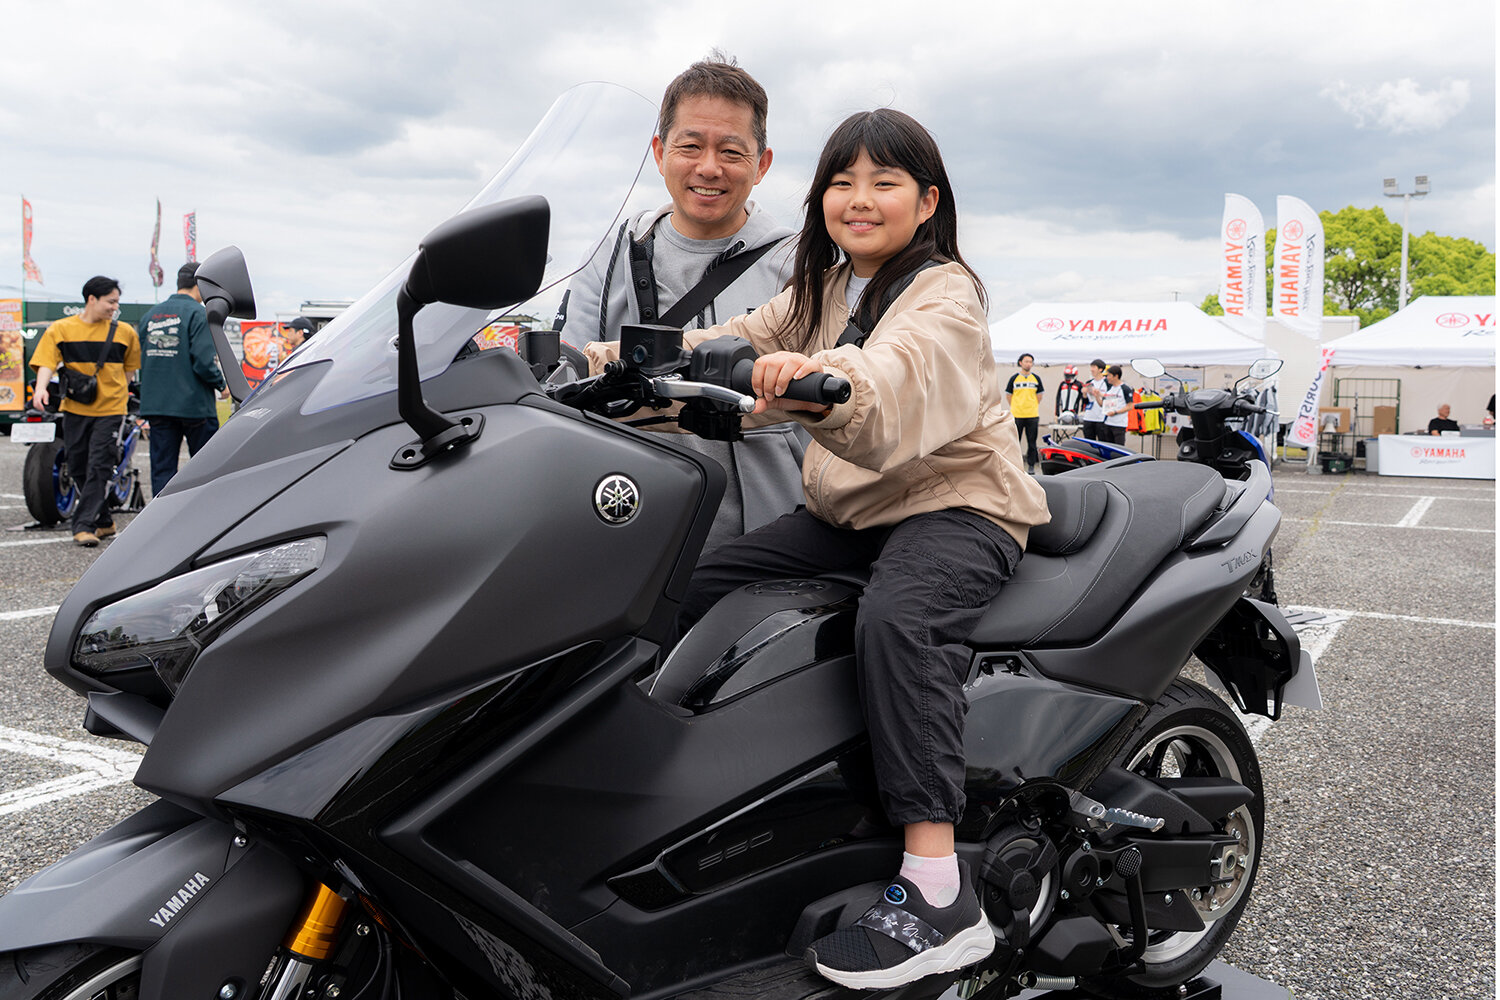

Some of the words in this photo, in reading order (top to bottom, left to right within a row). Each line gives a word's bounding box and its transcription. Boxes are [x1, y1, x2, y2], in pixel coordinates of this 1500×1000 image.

[1069, 319, 1168, 332] YAMAHA
[1423, 448, 1466, 458] YAMAHA
[149, 871, 210, 927] YAMAHA
